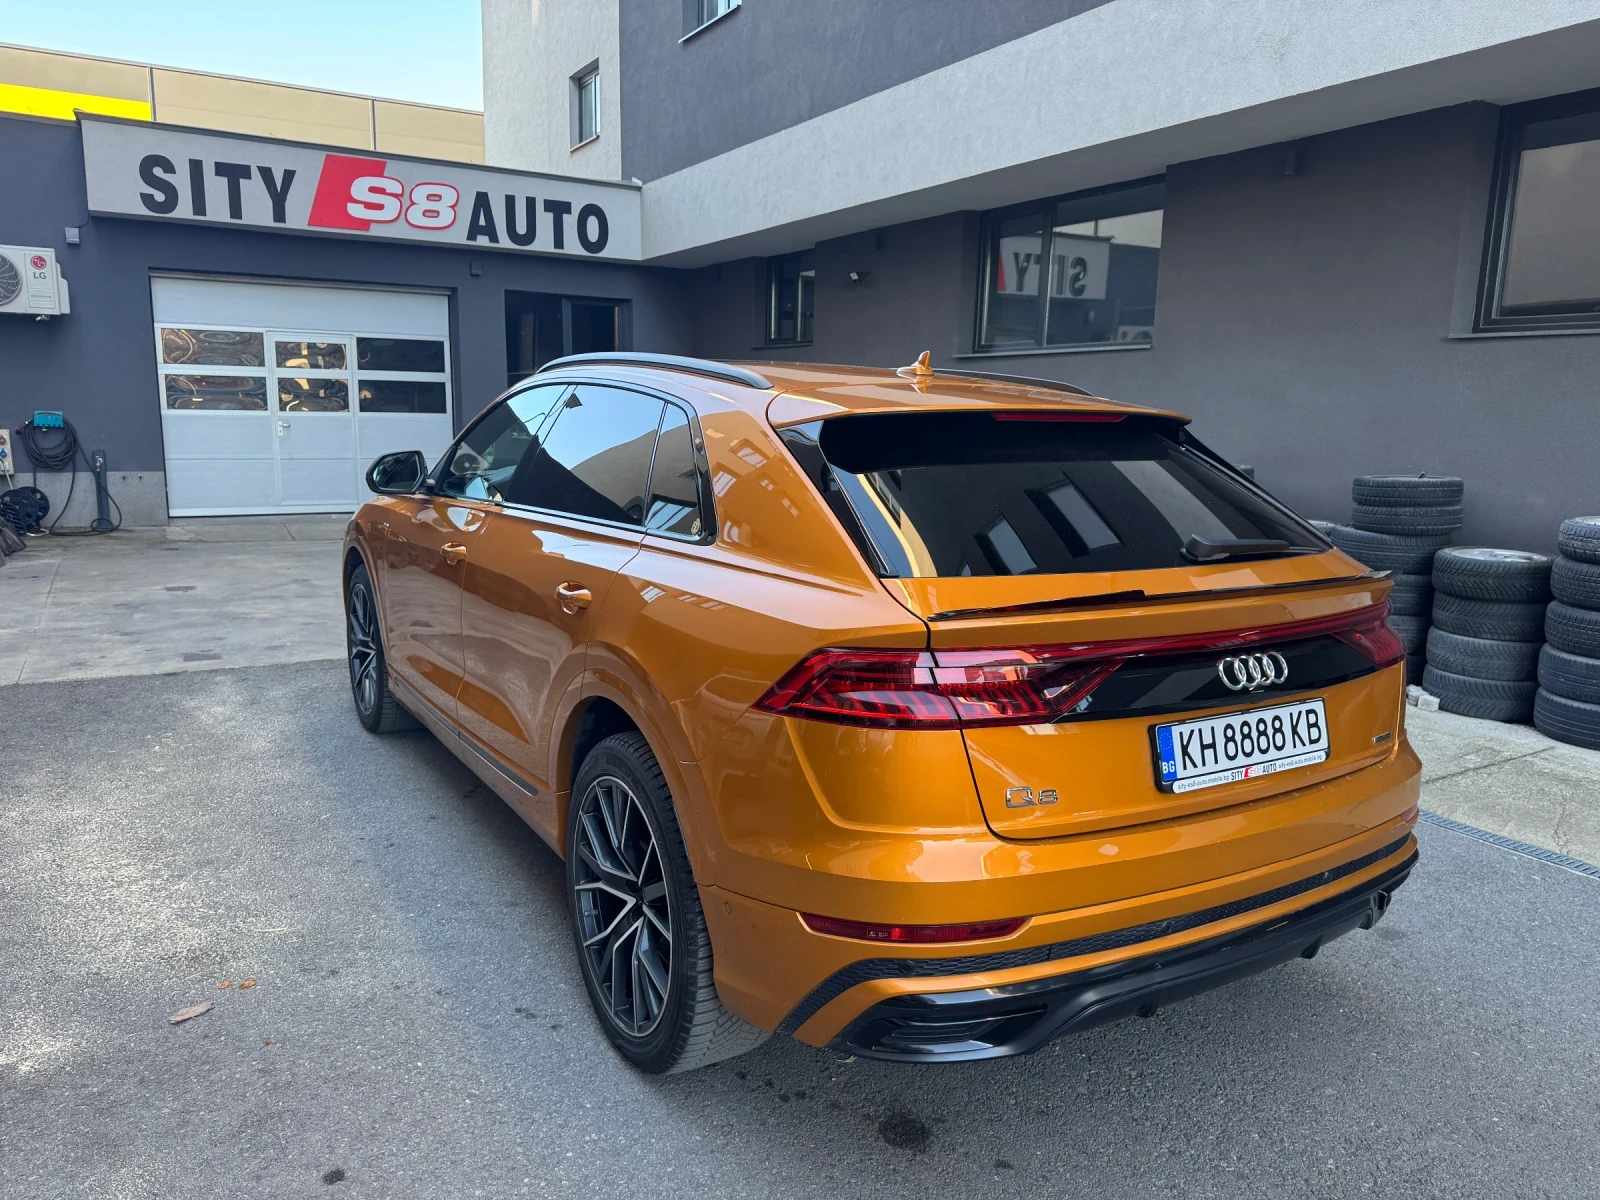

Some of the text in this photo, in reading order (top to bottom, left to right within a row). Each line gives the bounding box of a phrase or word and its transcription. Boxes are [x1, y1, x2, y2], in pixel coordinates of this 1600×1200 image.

[139, 154, 609, 254] SITY S8 AUTO
[33, 272, 46, 280] LG
[1162, 761, 1175, 774] BG
[1231, 770, 1244, 780] SITY
[1262, 763, 1276, 774] AUTO
[1006, 786, 1058, 808] Q8
